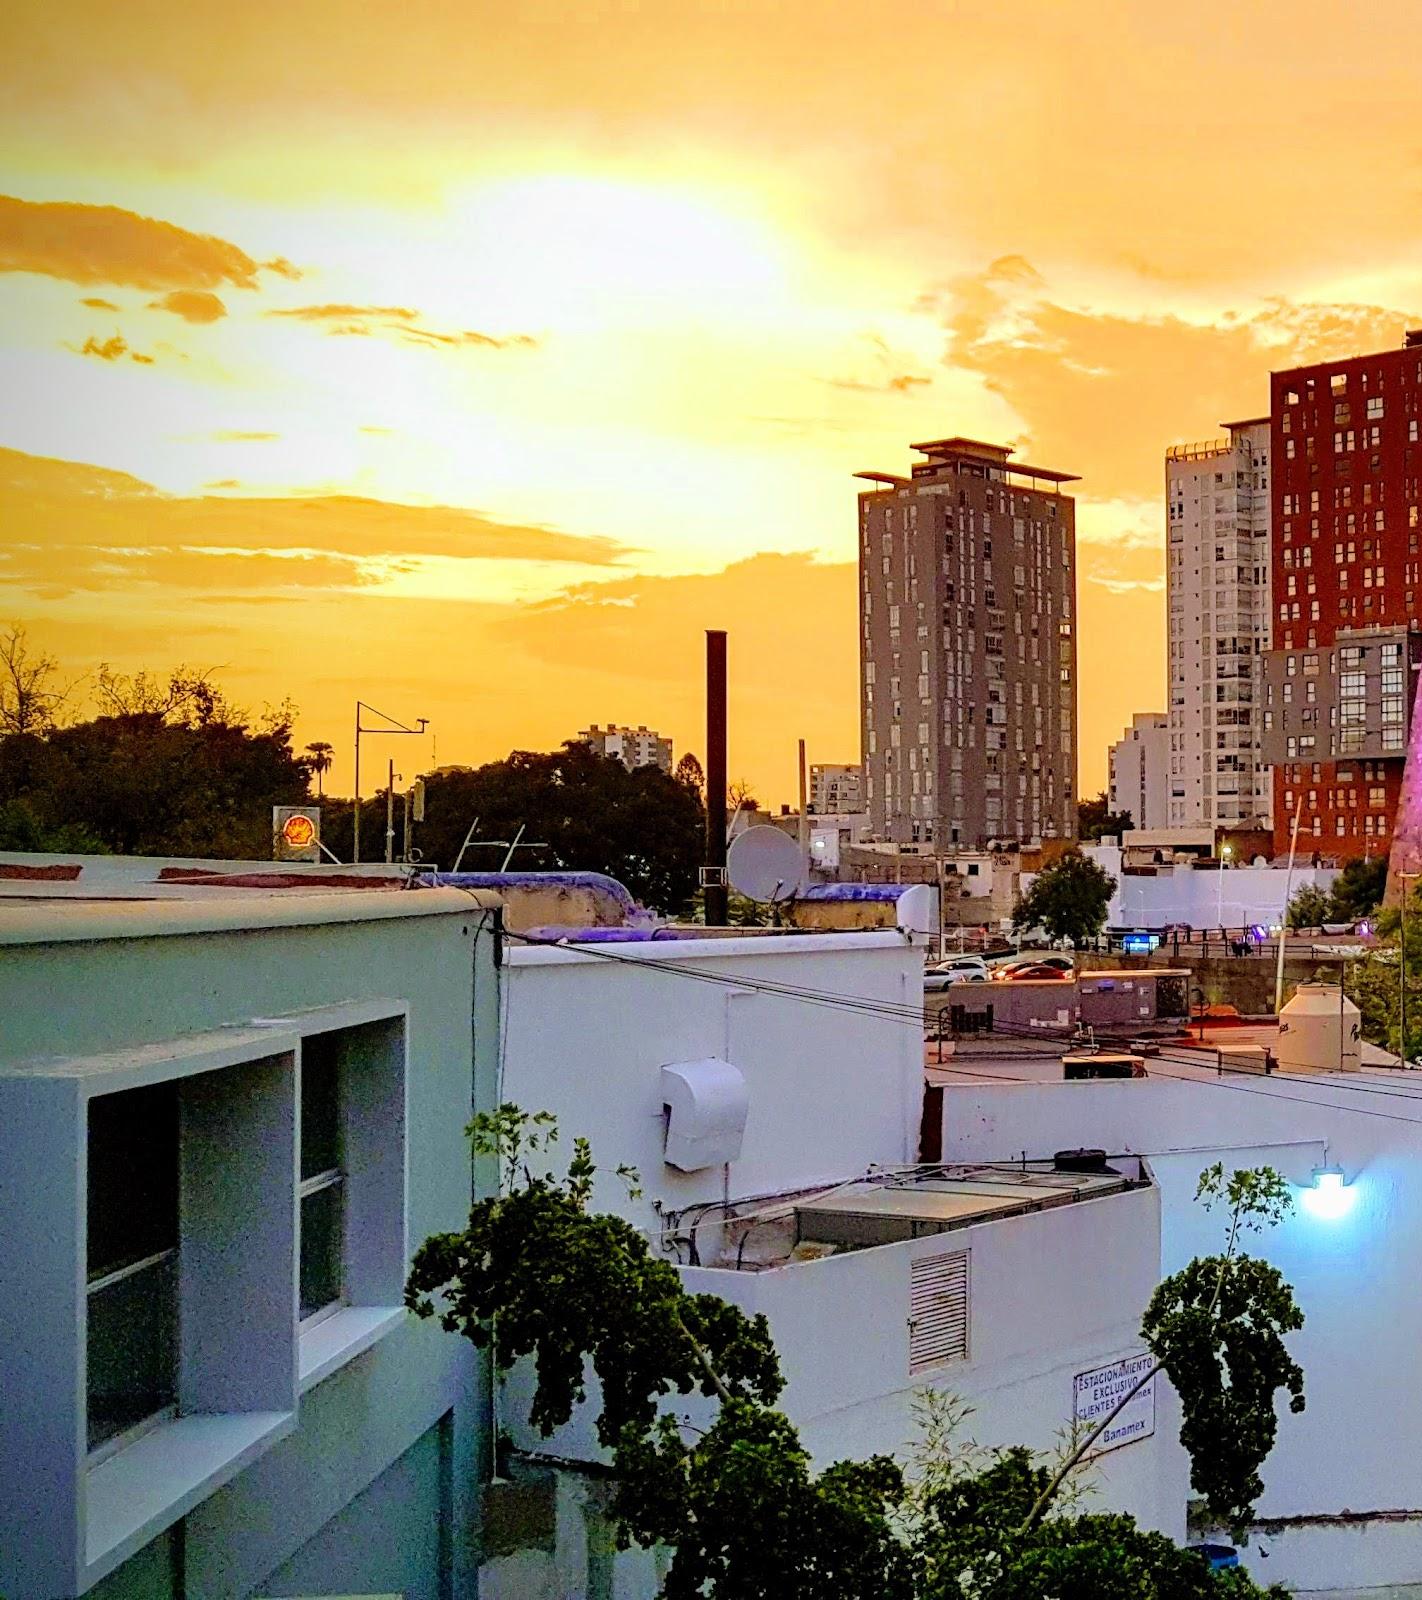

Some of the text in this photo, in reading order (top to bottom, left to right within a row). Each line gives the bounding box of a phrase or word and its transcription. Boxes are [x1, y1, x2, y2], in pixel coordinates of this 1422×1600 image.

[1079, 1357, 1152, 1391] ESTACIONAMIENTO
[1093, 1376, 1138, 1401] EXCLUSIVO
[1079, 1398, 1115, 1418] CLIENTES
[1103, 1420, 1145, 1443] Banamex
